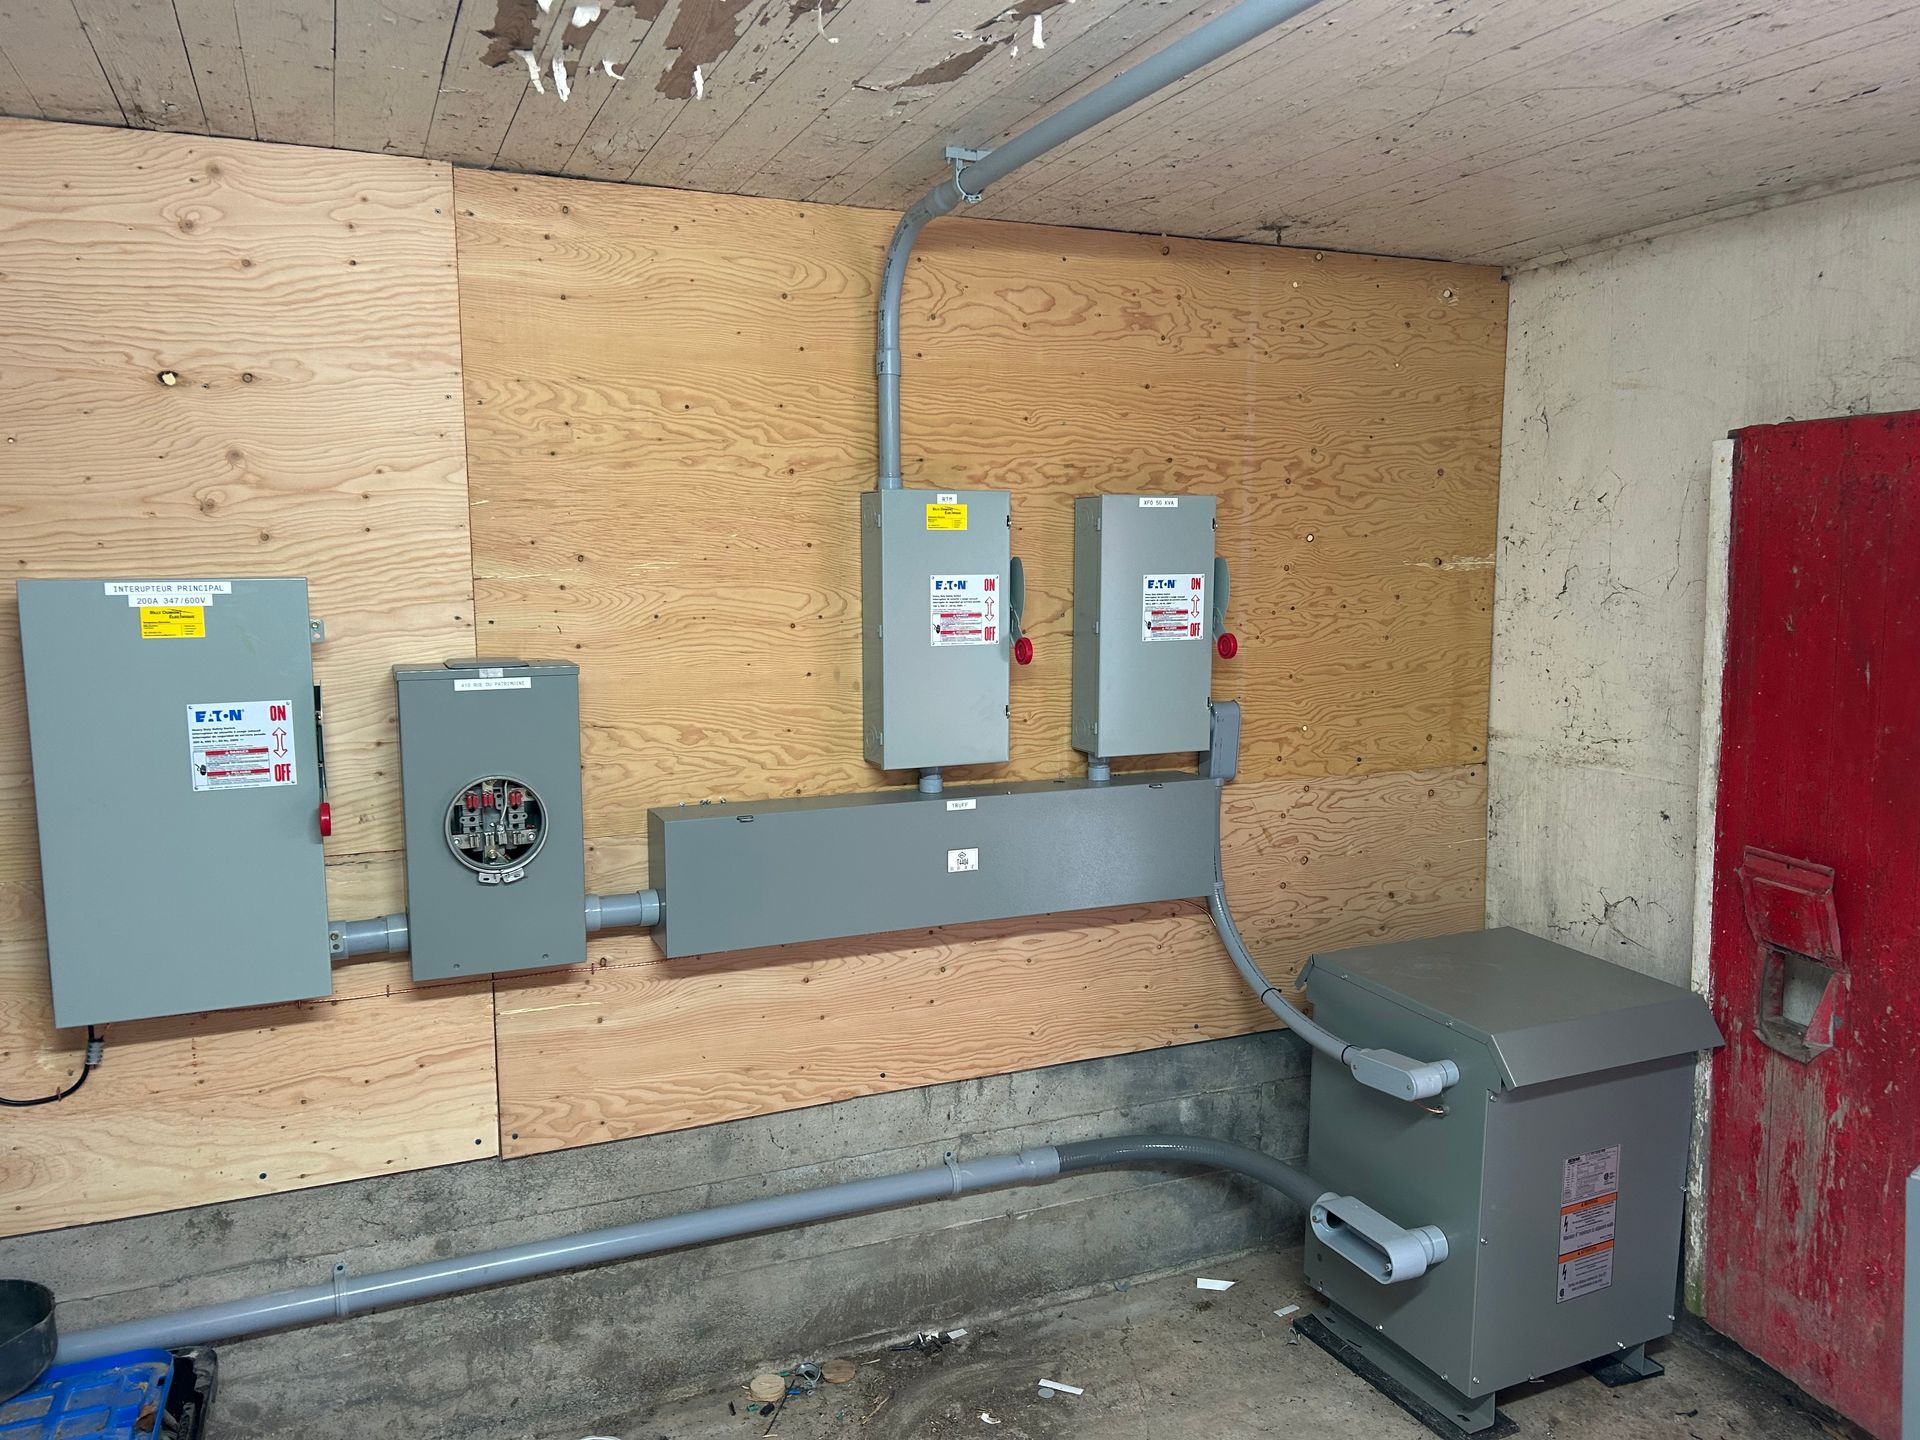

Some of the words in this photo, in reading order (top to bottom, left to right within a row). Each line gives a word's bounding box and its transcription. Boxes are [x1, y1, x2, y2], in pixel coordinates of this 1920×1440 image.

[113, 585, 172, 593] INTERUPTEUR
[177, 584, 224, 592] PRINCIPAL
[984, 578, 995, 592] ON
[1191, 577, 1201, 590] ON
[137, 597, 159, 605] 200A
[163, 596, 206, 604] 347/600V
[984, 626, 996, 642] OFF
[1189, 622, 1201, 637] OFF
[269, 705, 287, 722] ON
[274, 763, 291, 782] OFF
